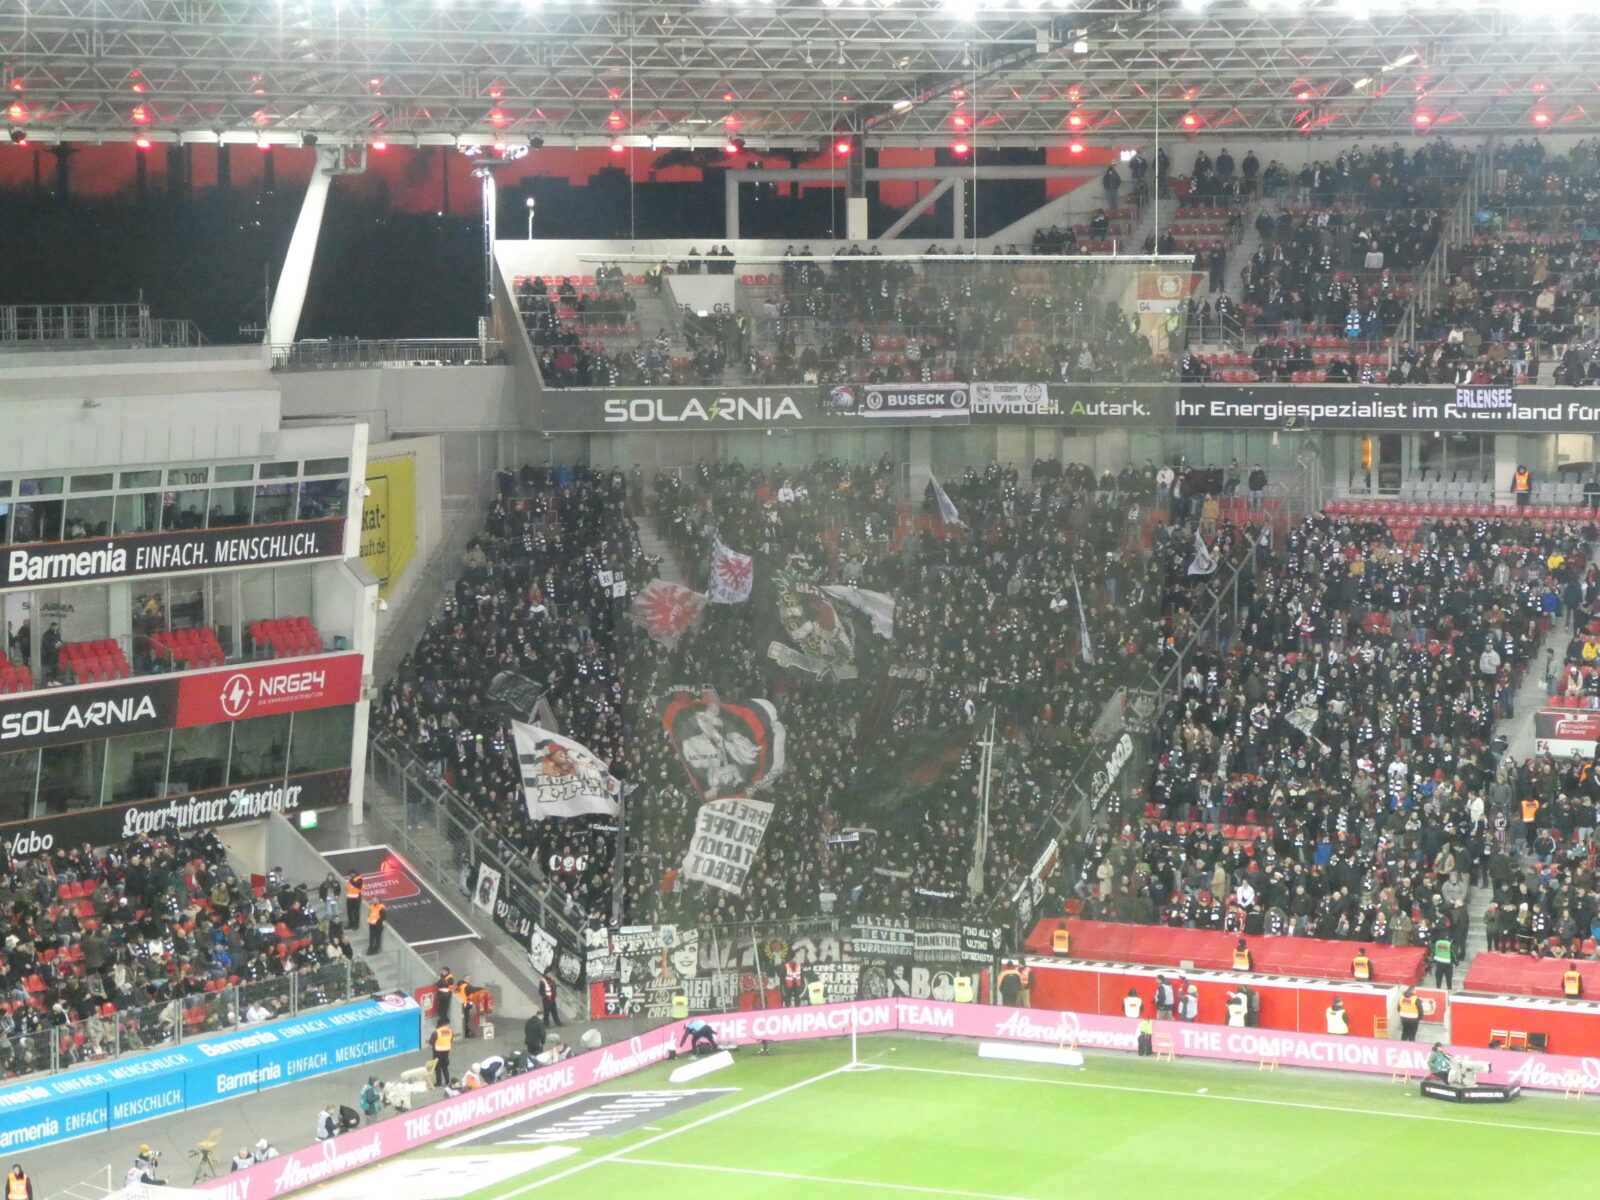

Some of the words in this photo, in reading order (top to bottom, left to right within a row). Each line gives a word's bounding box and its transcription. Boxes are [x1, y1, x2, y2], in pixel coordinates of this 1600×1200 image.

[713, 302, 730, 314] G5
[1140, 302, 1150, 311] G4
[604, 397, 802, 423] SOLARNIA
[888, 394, 945, 406] BUSECK
[1070, 401, 1151, 416] Autark.
[1175, 400, 1205, 416] Ihr
[1210, 401, 1407, 421] Energiespezialist
[1413, 402, 1438, 418] im
[1456, 388, 1513, 409] ERLENSEE
[8, 543, 127, 582] Barmenia
[135, 541, 208, 570] EINFACH.
[214, 533, 320, 563] MENSCHLICH.
[259, 670, 326, 697] NRG24
[1, 695, 157, 740] SOLARNIA
[1537, 741, 1550, 752] F4
[122, 796, 228, 838] Leverkusener
[228, 784, 302, 819] Anzeiger
[11, 829, 53, 855] /abo
[857, 915, 910, 928] ULTRAS
[861, 929, 906, 942] NEVER
[714, 1018, 747, 1041] THE
[752, 1003, 890, 1037] COMPACTION
[895, 1003, 954, 1028] TEAM
[198, 1030, 280, 1057] Barmenia
[278, 1019, 333, 1039] EINFACH.
[1181, 1029, 1221, 1050] THE
[1227, 1034, 1378, 1064] COMPACTION
[51, 1072, 112, 1095] EINFACH.
[108, 1053, 193, 1081] MENSCHLICH.
[216, 1061, 281, 1094] Barmenia
[335, 1035, 398, 1063] MENSCHLICH.
[114, 1089, 184, 1120] MENSCHLICH.
[404, 1116, 432, 1141] THE
[434, 1082, 528, 1130] COMPACTION
[528, 1065, 575, 1099] PEOPLE
